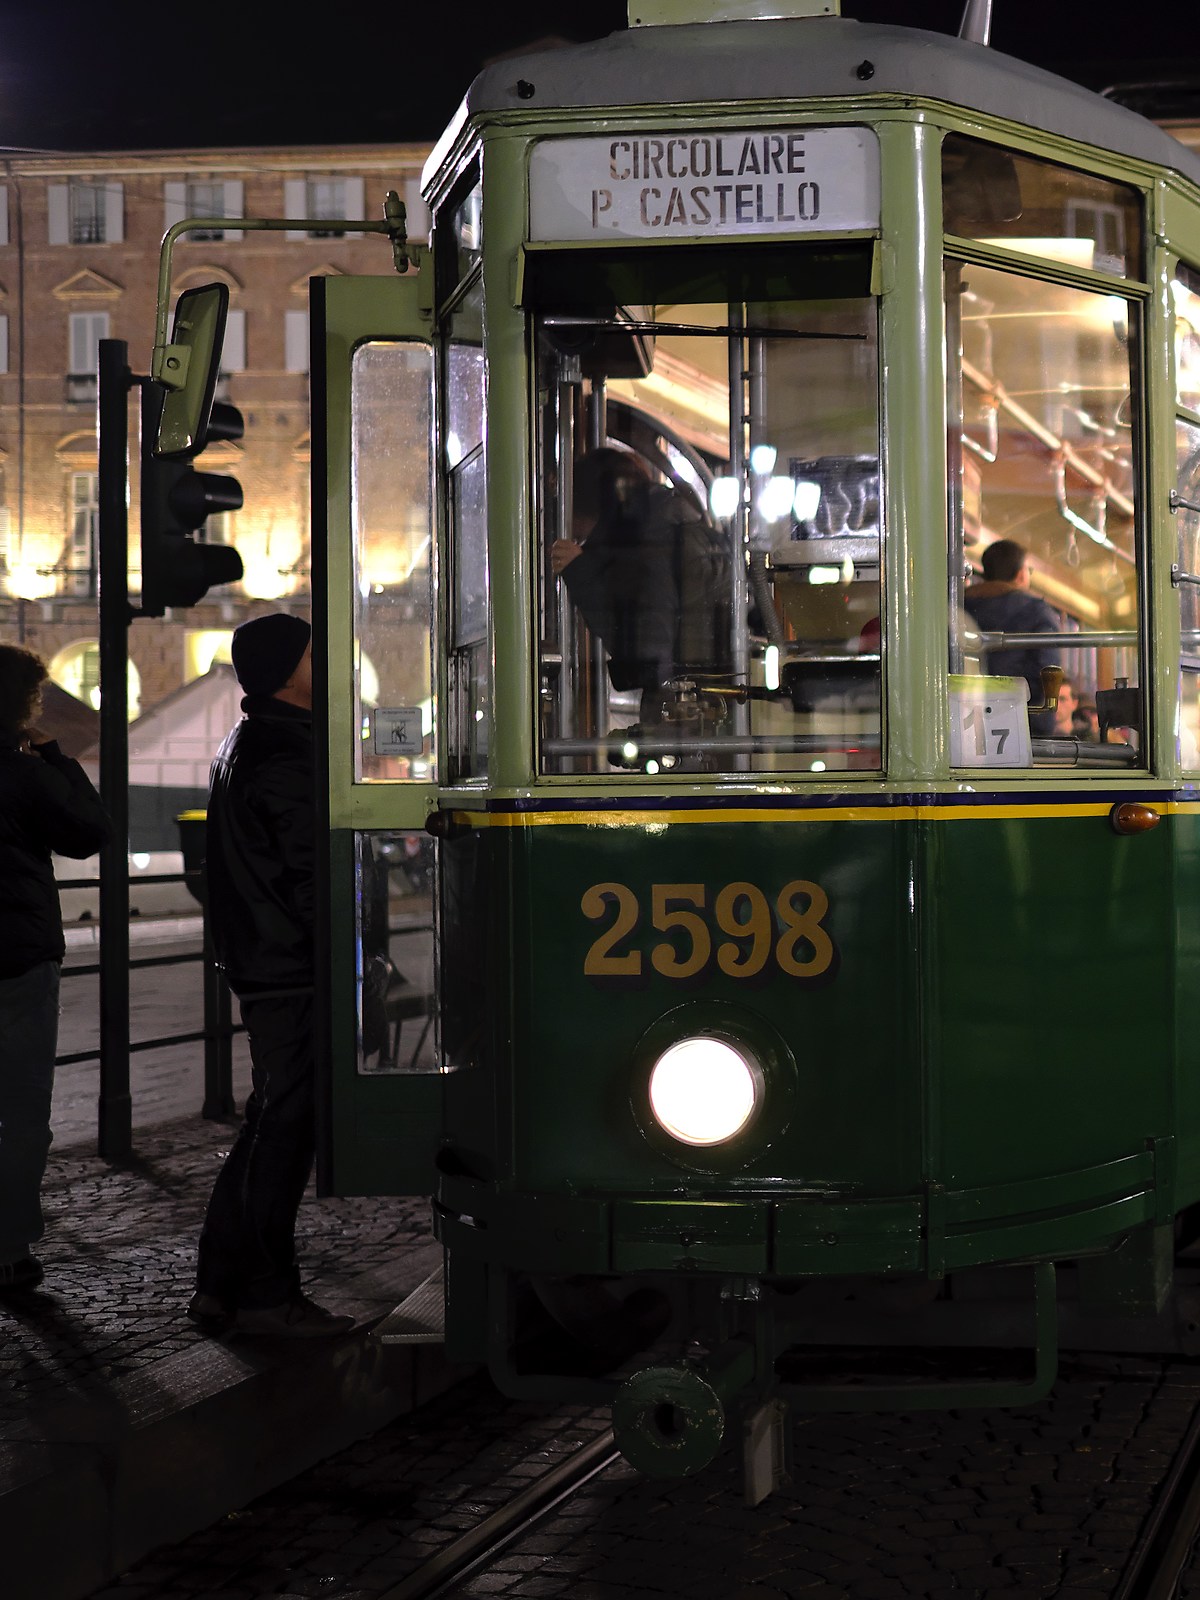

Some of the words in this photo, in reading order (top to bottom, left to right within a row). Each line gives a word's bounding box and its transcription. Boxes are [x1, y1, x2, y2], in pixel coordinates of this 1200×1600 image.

[609, 133, 806, 181] CIRCOLARE
[591, 188, 620, 229] P.
[639, 181, 821, 227] CASTELLO
[580, 879, 834, 978] 2598
